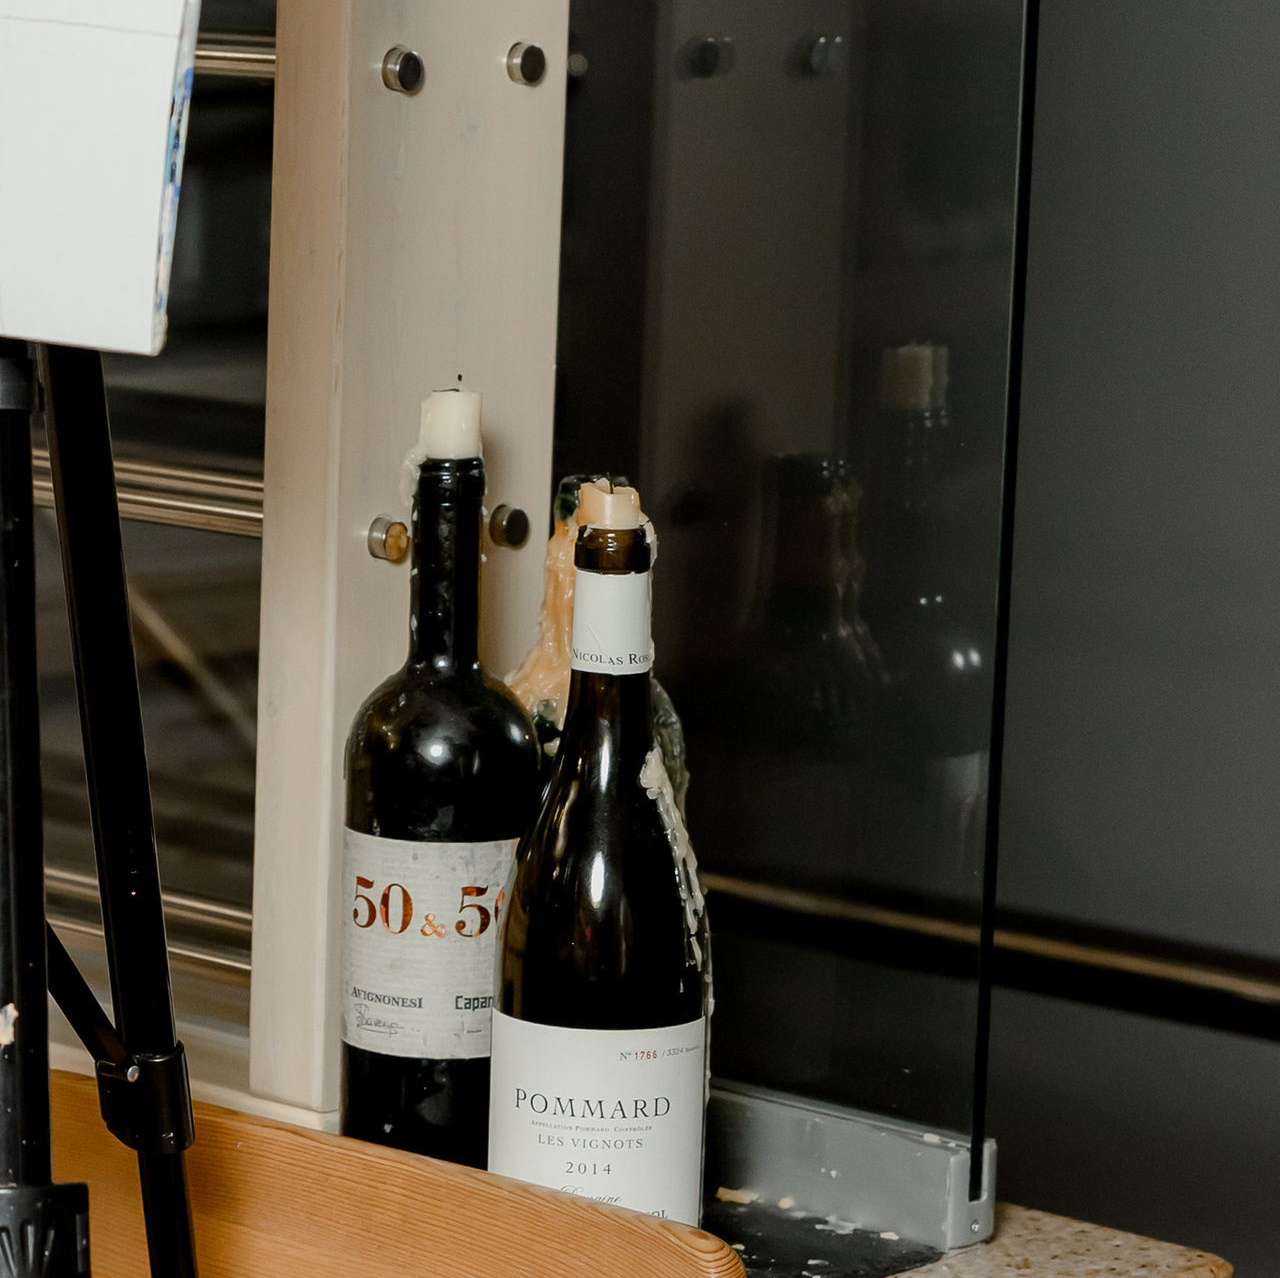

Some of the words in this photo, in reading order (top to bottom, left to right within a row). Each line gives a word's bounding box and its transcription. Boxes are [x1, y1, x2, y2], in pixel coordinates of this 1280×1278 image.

[572, 648, 624, 665] NICOLAS
[353, 876, 413, 935] 50
[420, 912, 447, 938] &
[351, 986, 424, 1009] AVIGNONESI
[634, 1050, 658, 1060] 1766
[515, 1088, 671, 1119] POMMARD
[538, 1133, 565, 1147] LES
[571, 1138, 644, 1150] VIGNOTS
[565, 1161, 612, 1175] 2014
